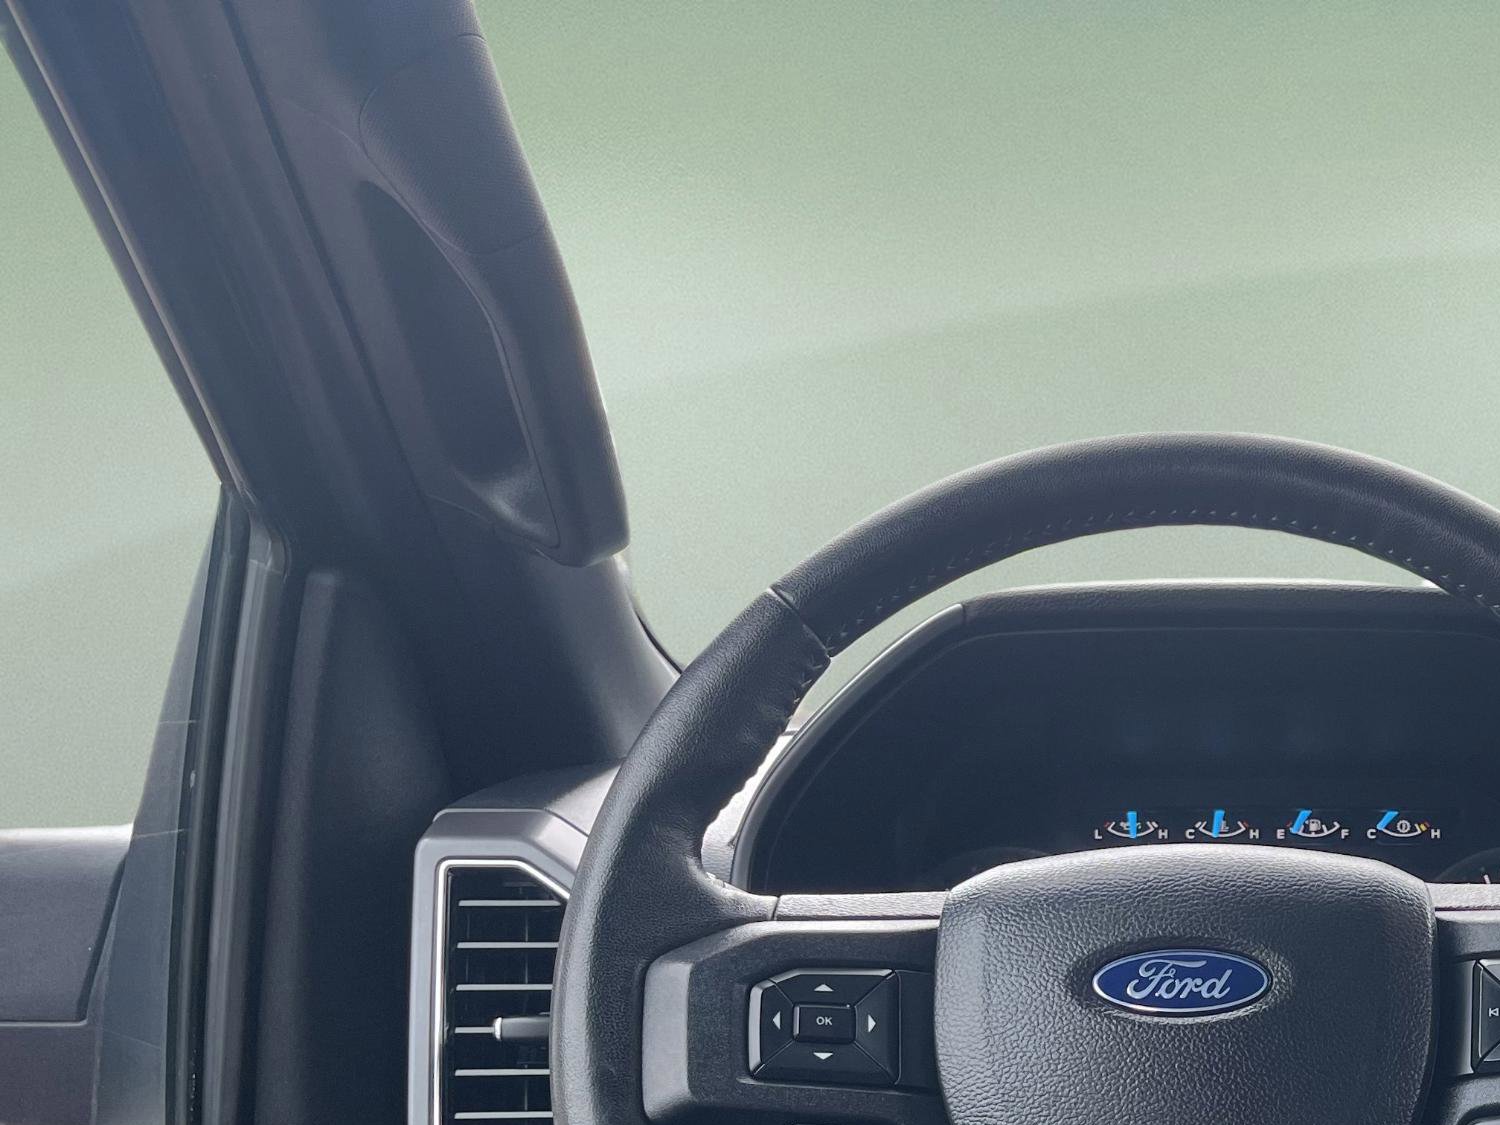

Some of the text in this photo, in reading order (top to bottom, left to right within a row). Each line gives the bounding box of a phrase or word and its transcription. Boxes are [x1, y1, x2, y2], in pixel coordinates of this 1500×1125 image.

[1094, 829, 1168, 839] L H
[1185, 829, 1259, 839] C H
[1276, 829, 1349, 839] E F
[1366, 829, 1441, 839] C H
[1126, 959, 1233, 999] Ford
[816, 1016, 833, 1025] OK
